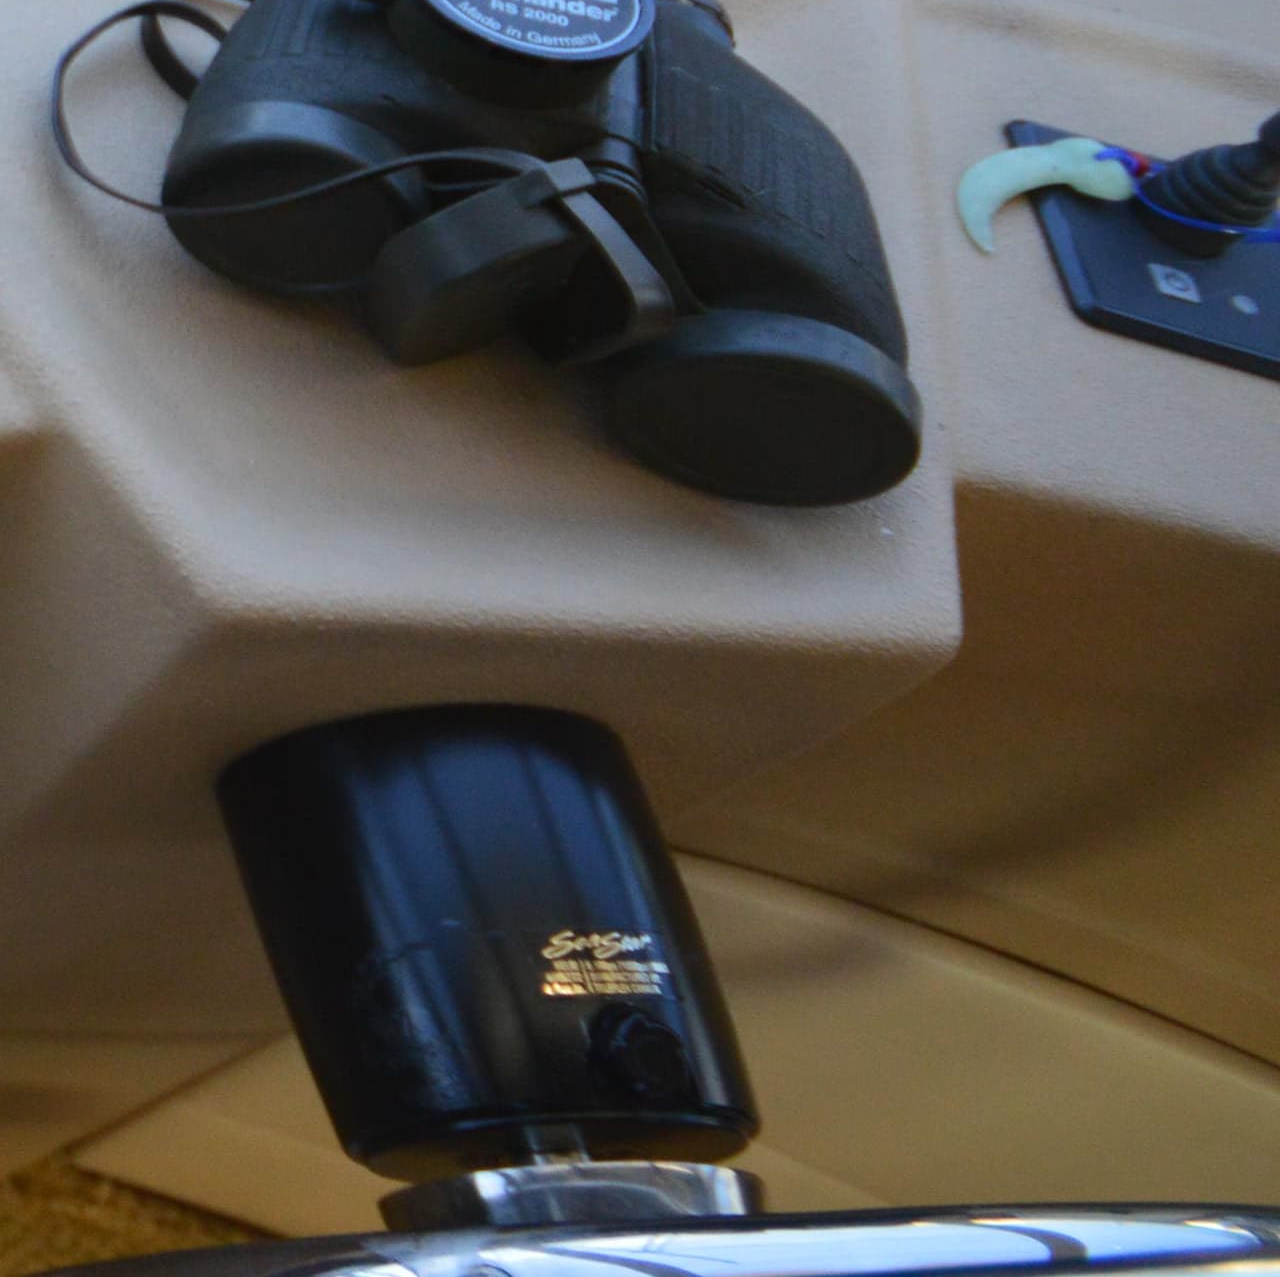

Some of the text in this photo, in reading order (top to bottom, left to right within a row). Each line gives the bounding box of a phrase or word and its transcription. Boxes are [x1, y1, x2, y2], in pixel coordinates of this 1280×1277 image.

[457, 0, 604, 47] Made in Germany
[523, 6, 570, 27] 2000
